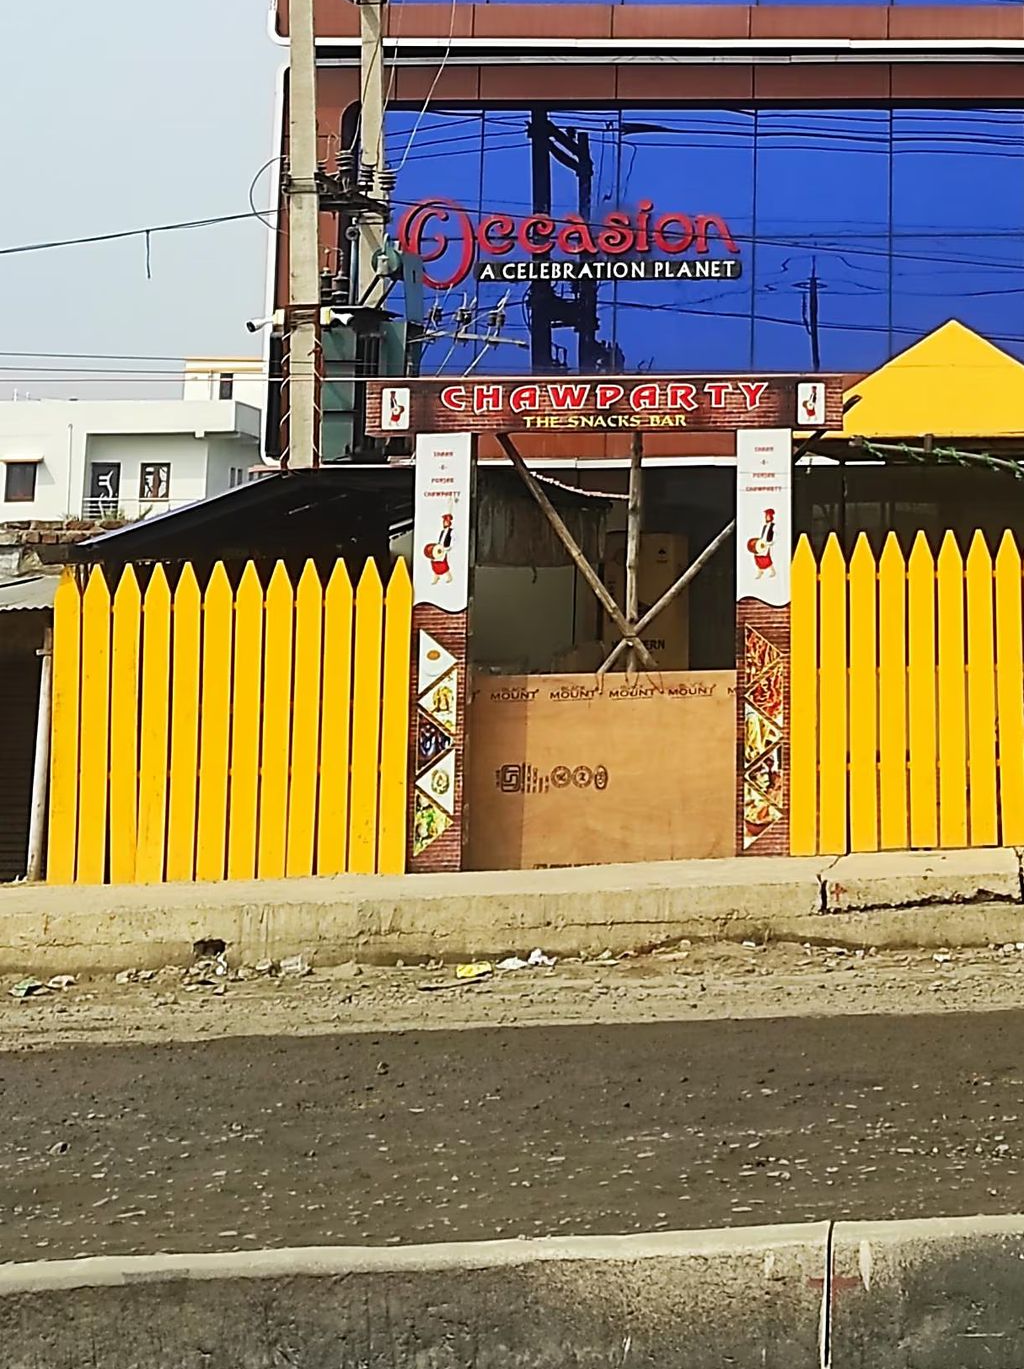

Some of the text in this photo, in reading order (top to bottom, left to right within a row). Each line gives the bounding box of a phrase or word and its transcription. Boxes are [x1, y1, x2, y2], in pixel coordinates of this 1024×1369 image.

[398, 196, 741, 290] Occasion
[479, 259, 737, 281] A CELEBRATION PLANET
[440, 381, 771, 414] CHAWPARTY
[523, 414, 688, 430] THE SNACKS BAR
[490, 688, 540, 701] MOUNT
[549, 686, 598, 700] MOUNT
[608, 687, 656, 698] MOUNT
[667, 683, 717, 696] MOUNT
